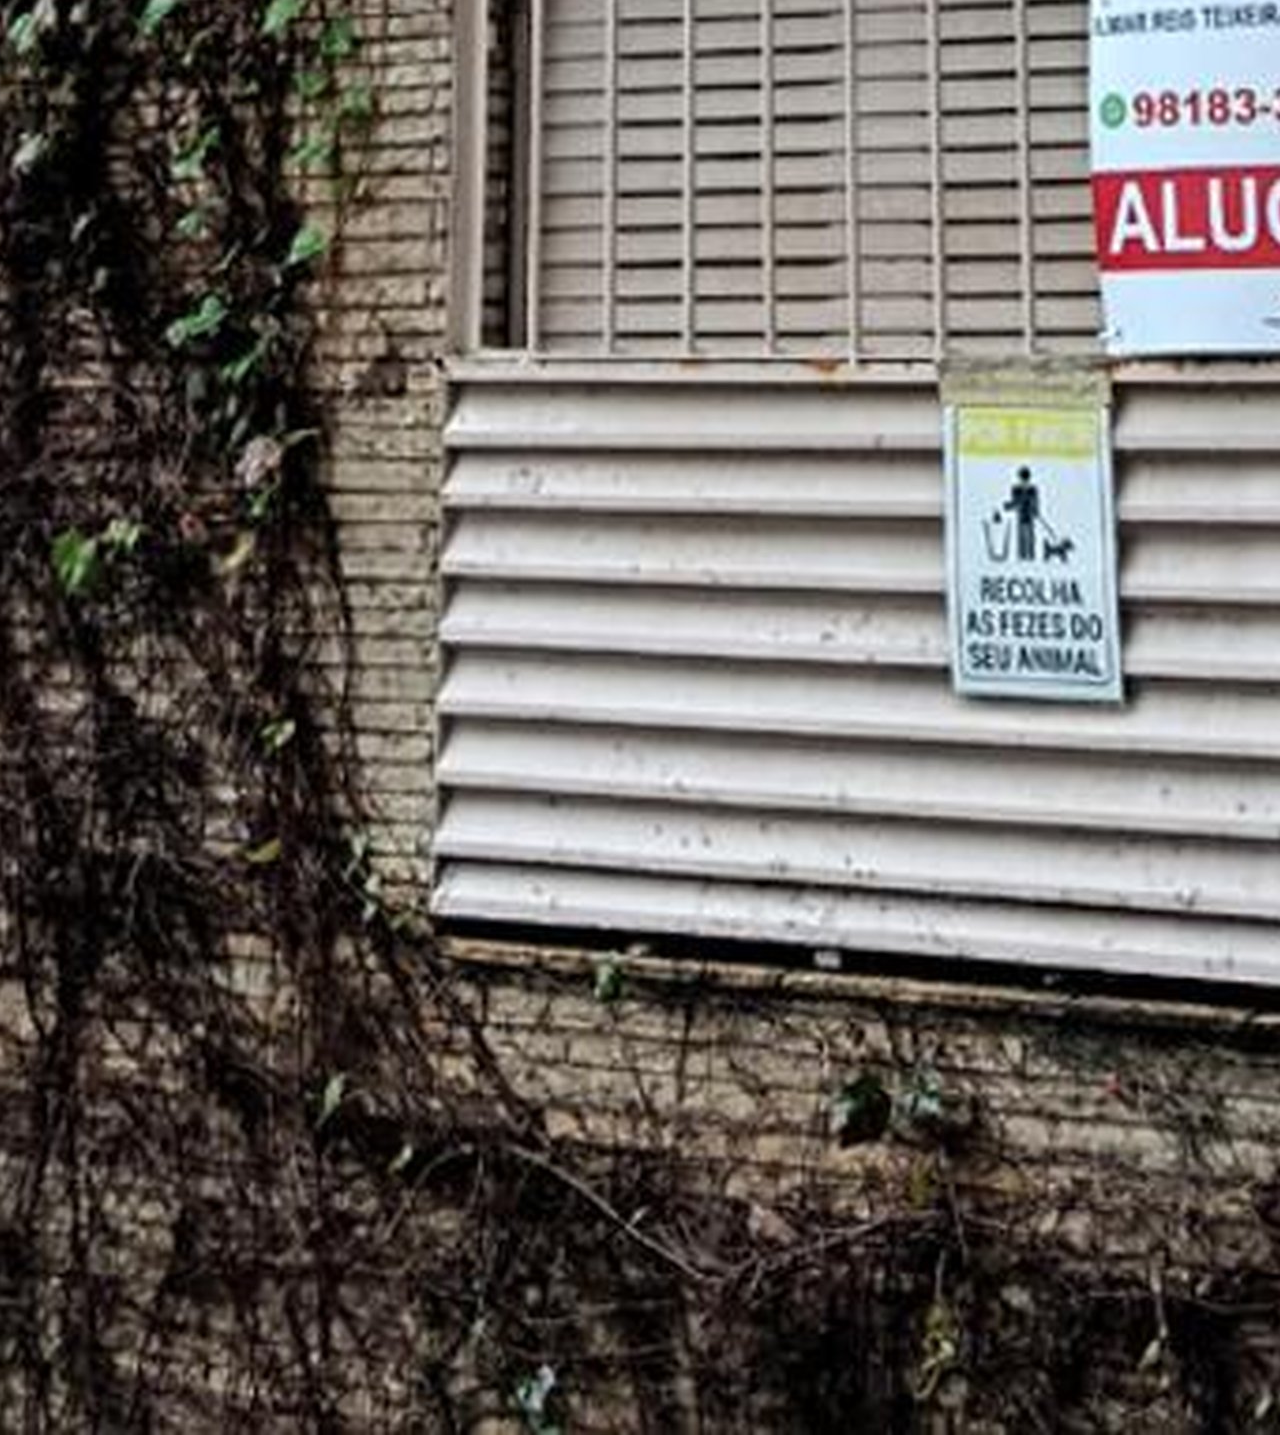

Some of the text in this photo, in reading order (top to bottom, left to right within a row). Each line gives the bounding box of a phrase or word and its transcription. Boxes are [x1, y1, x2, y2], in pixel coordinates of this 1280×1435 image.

[981, 576, 1083, 605] RECOLHA
[967, 610, 1103, 641] AS FEZES DO
[970, 644, 1103, 677] SEU ANIMAL
